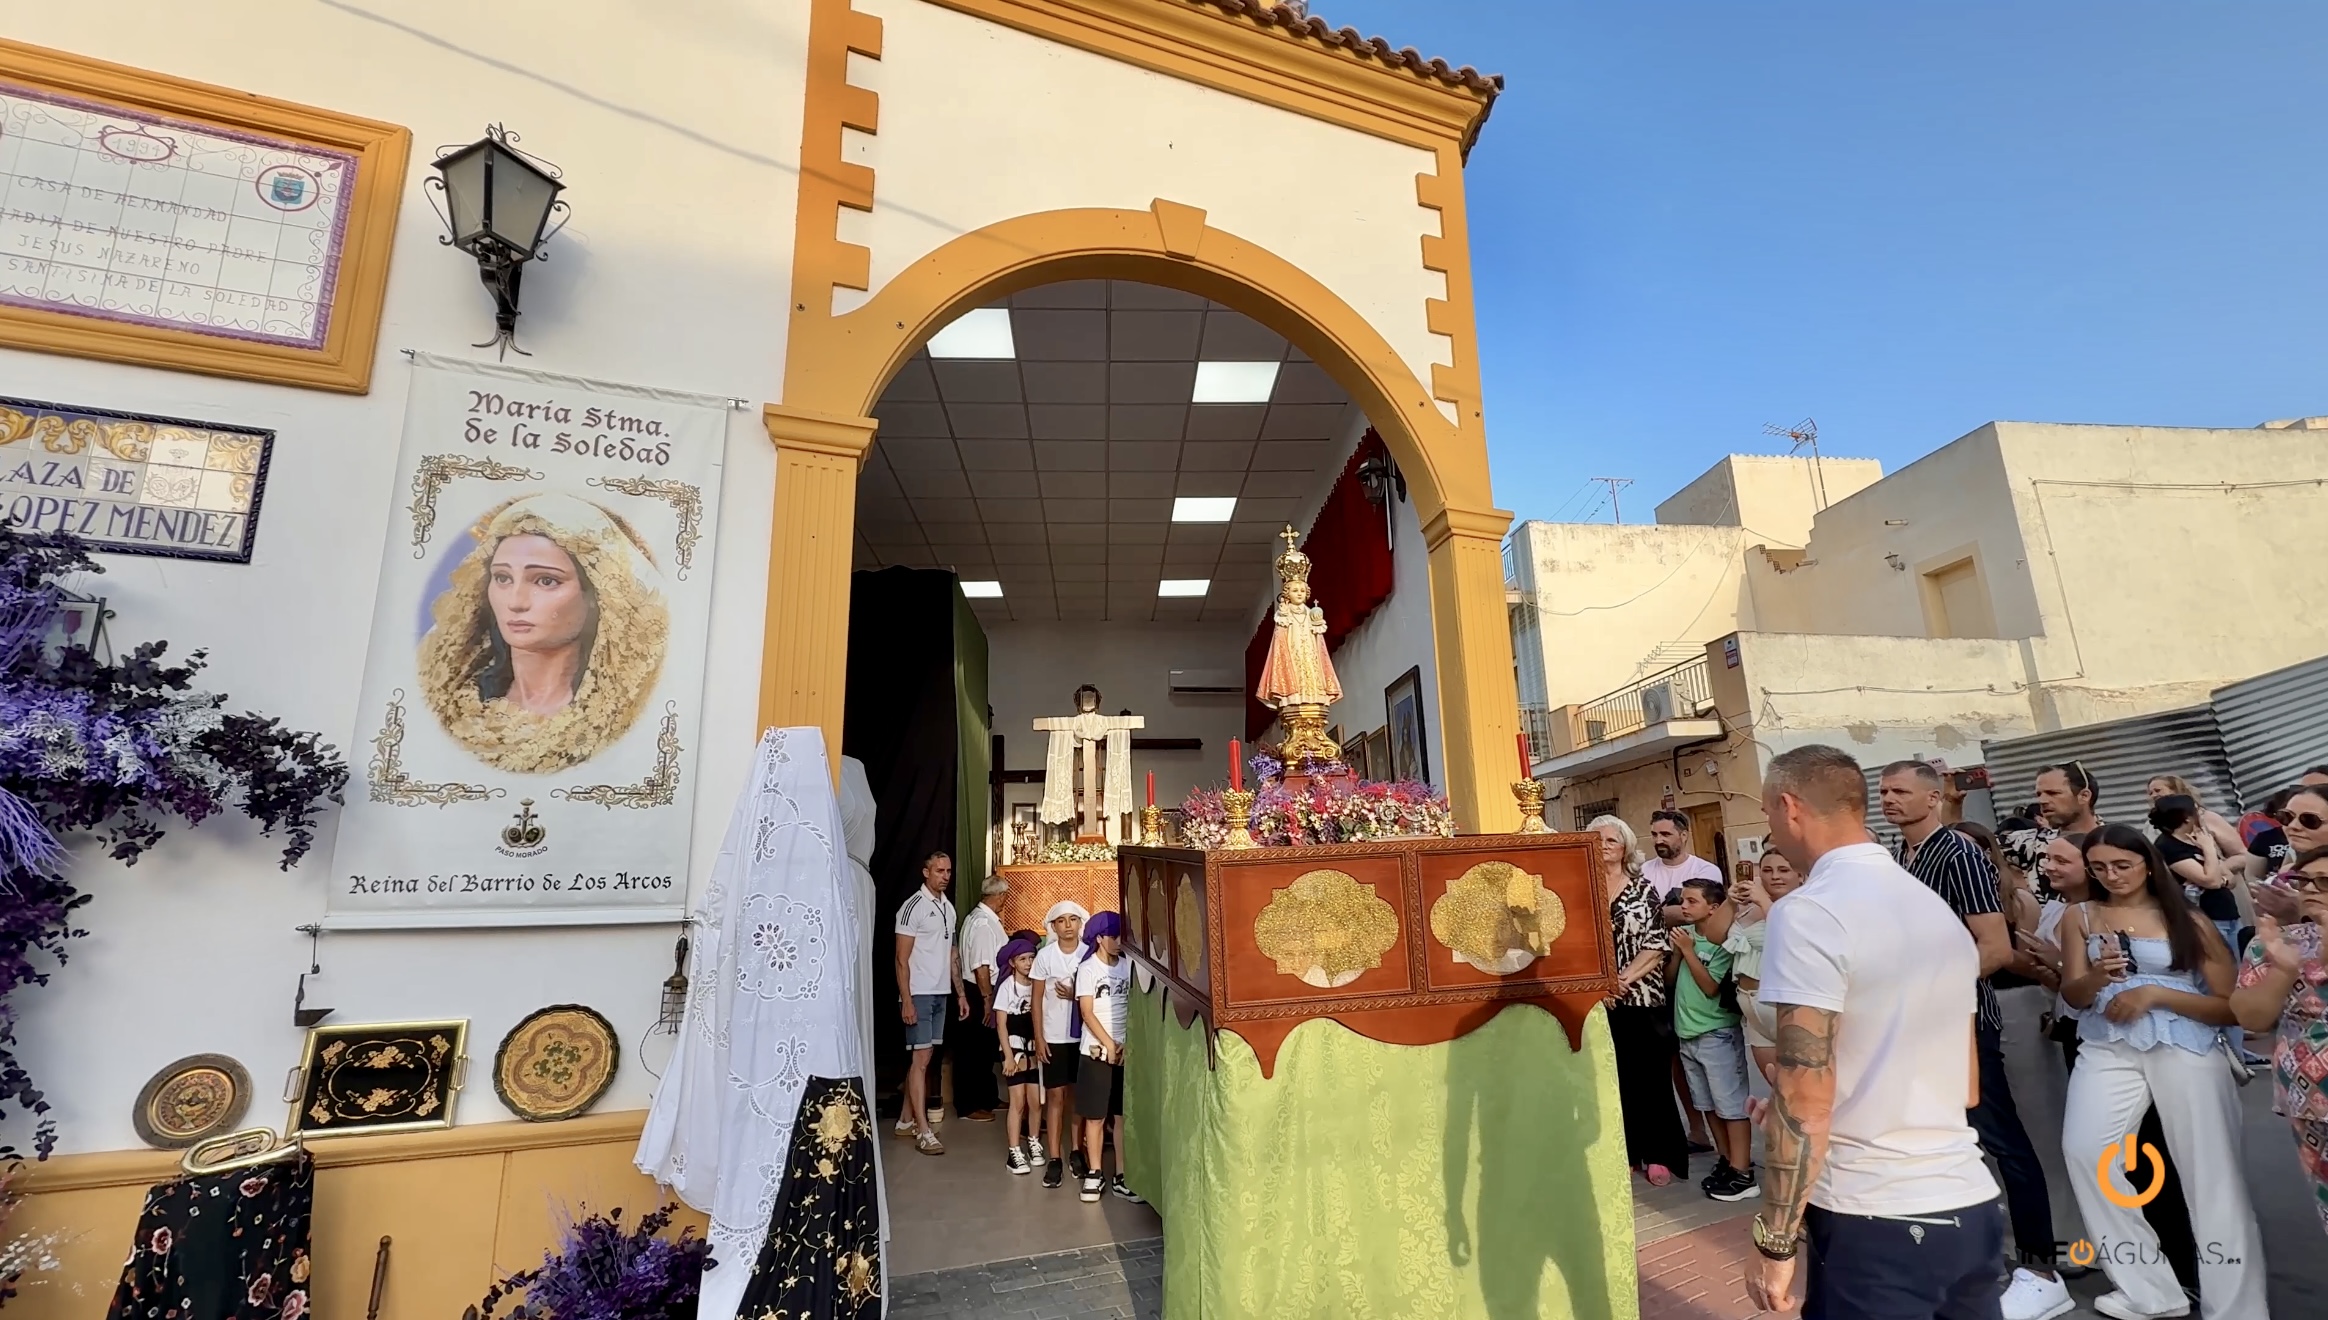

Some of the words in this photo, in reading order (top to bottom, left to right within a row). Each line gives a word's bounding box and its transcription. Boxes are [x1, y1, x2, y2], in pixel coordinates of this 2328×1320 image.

[17, 176, 71, 196] CASA
[81, 186, 103, 201] DE
[114, 193, 227, 222] HERMANDAD
[18, 233, 84, 255] JESUS
[97, 247, 200, 275] NAZARENO
[72, 219, 97, 234] DE
[106, 225, 196, 251] NUESTRO
[206, 242, 268, 263] PADRE
[7, 258, 128, 288] SANTISIMA
[136, 278, 158, 293] DE
[169, 283, 191, 298] LA
[203, 290, 288, 311] SOLEDAD
[464, 417, 498, 444] de
[511, 422, 541, 449] la
[550, 432, 671, 466] Soledad
[581, 407, 670, 437] Stma.
[0, 460, 86, 490] AZA
[100, 468, 136, 496] DE
[0, 492, 100, 536] OPEZ
[105, 503, 239, 549] MENDEZ
[495, 845, 515, 858] PASO
[515, 845, 548, 858] MORADO
[349, 874, 419, 894] Reina
[427, 874, 458, 892] del
[460, 873, 535, 893] Barrio
[543, 873, 561, 891] de
[568, 872, 606, 891] Los
[613, 871, 672, 890] Arcos
